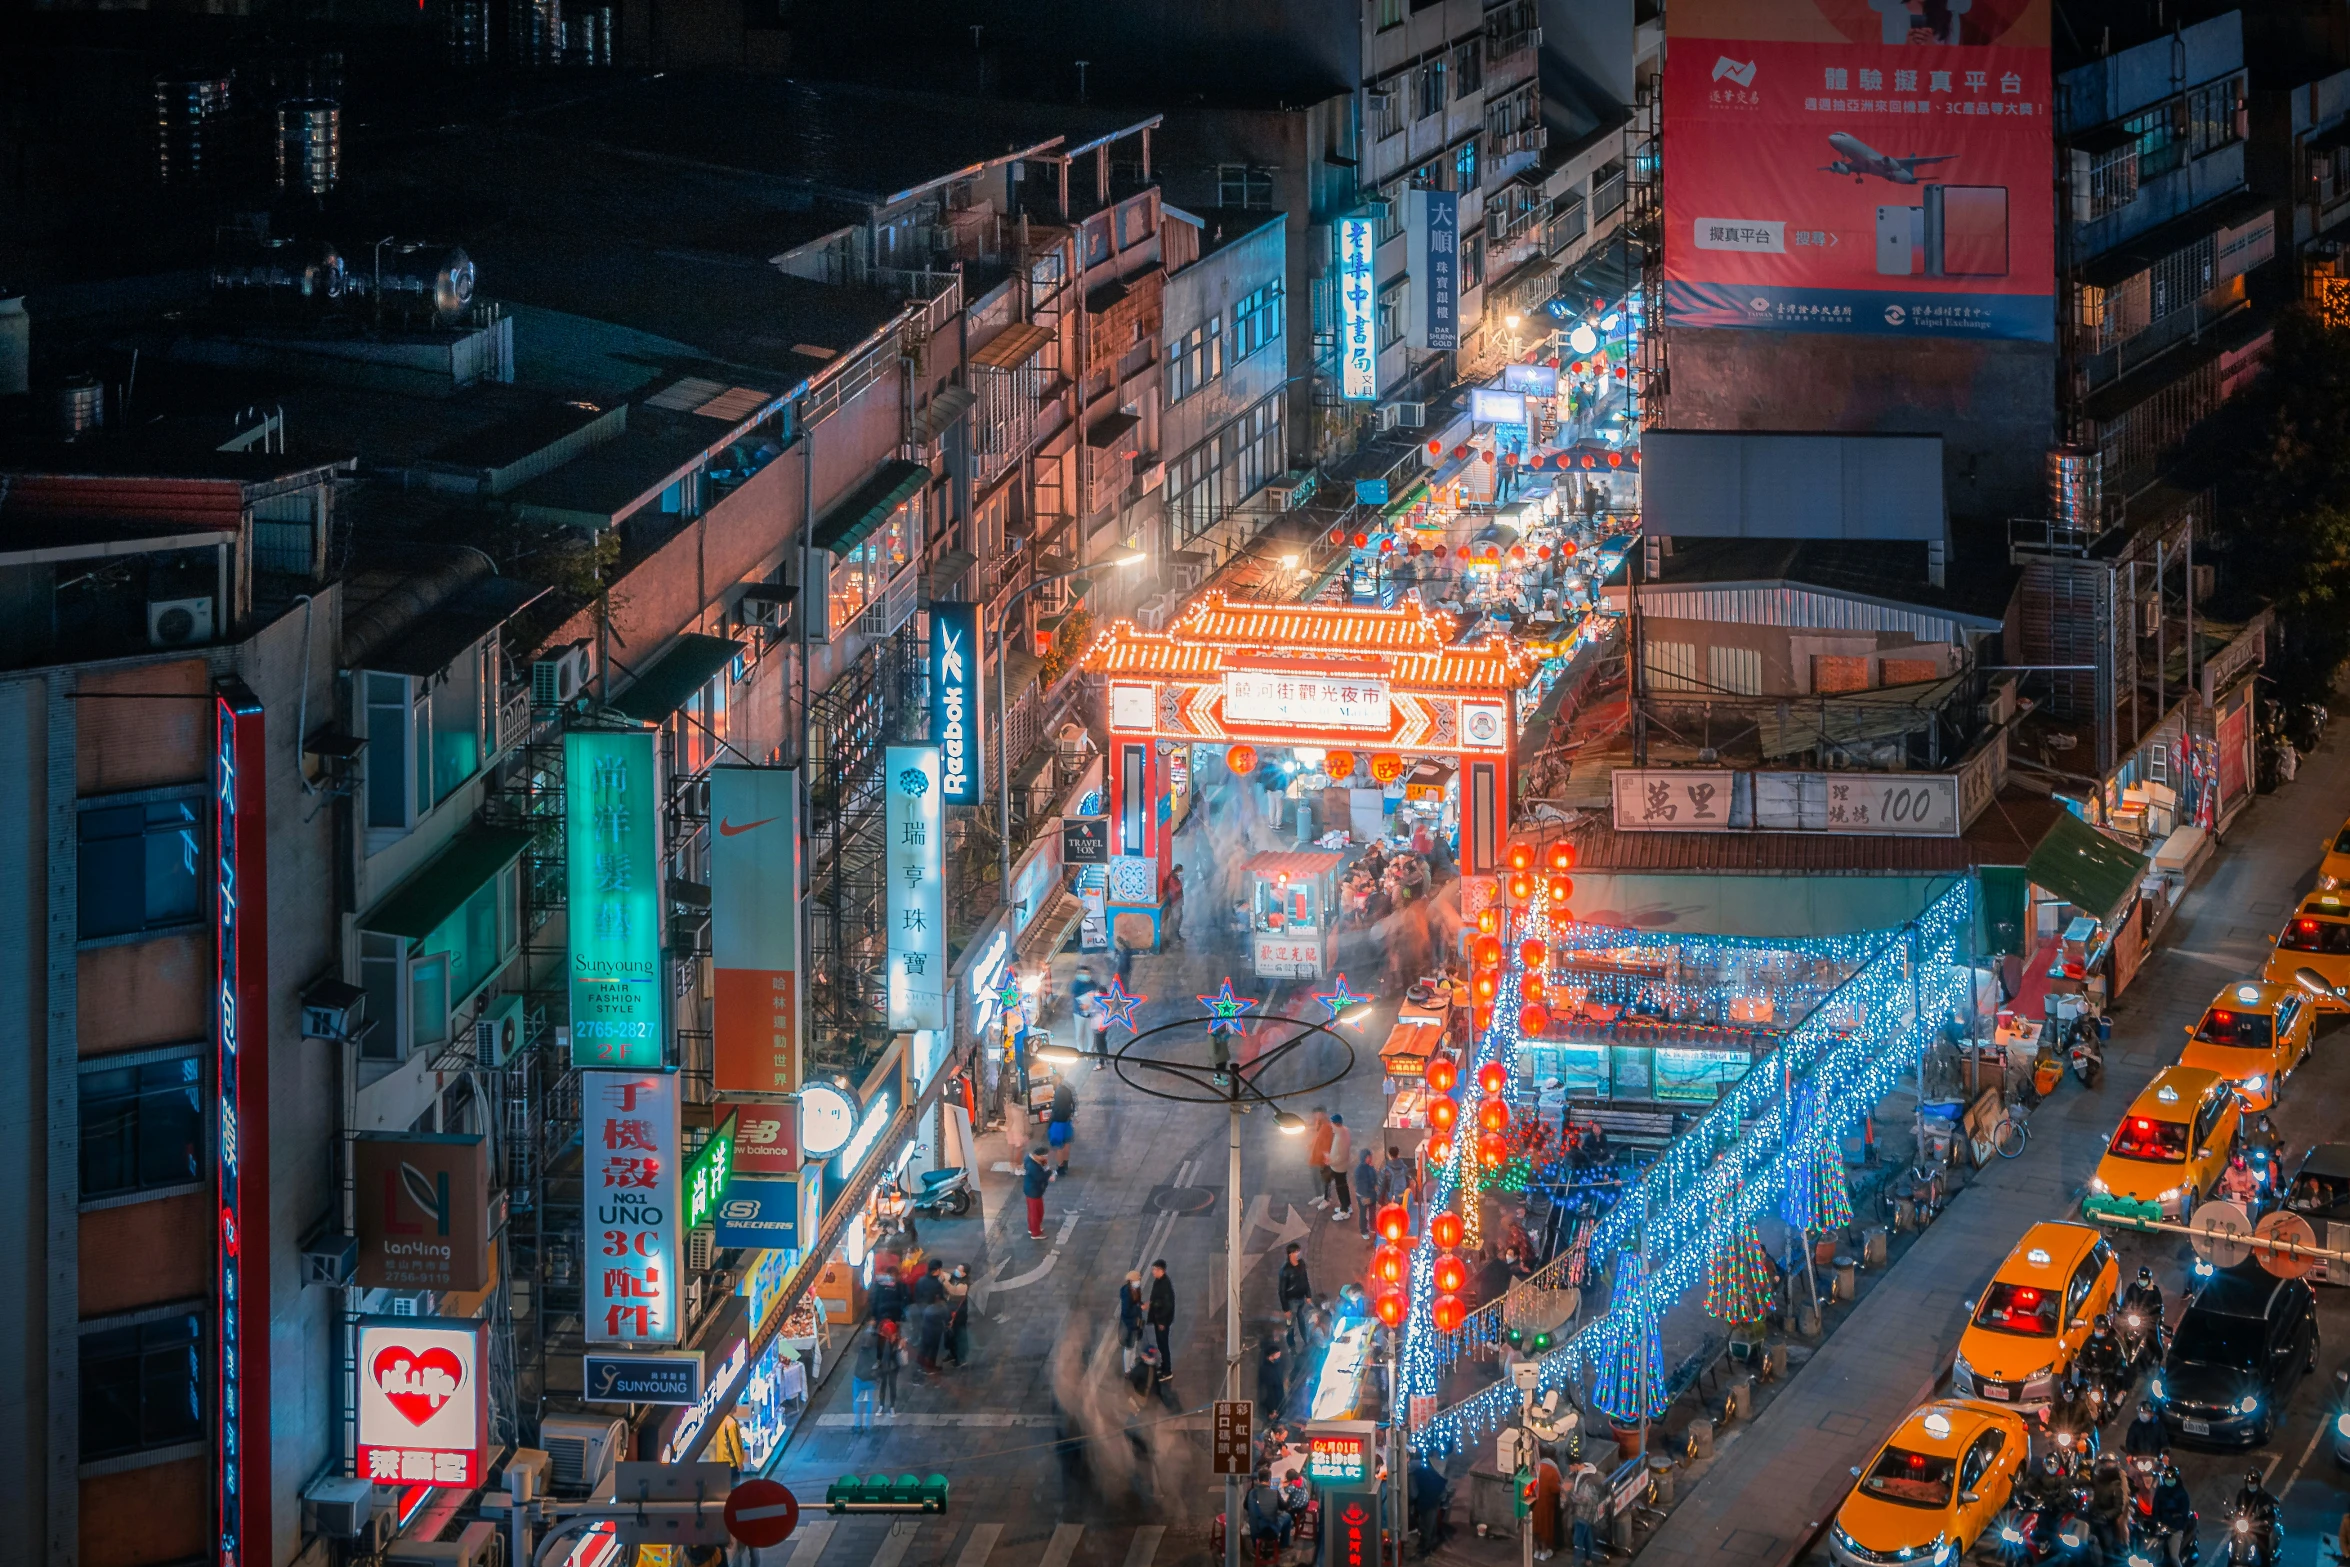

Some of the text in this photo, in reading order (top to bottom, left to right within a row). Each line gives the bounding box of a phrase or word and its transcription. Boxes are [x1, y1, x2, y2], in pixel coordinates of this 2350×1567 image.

[1824, 67, 2022, 95] 體驗擬真平台
[1708, 90, 1760, 105] 逐筆交易
[1430, 202, 1453, 255] 大順
[1709, 226, 1771, 245] 擬真平台
[1795, 230, 1826, 247] 搜尋
[1345, 221, 1372, 373] 老集中書局
[1436, 261, 1450, 320] 珠寶銀樓
[1434, 326, 1450, 334] DAR
[1913, 317, 1992, 330] Taipei Exchange
[1429, 332, 1456, 341] SHUENN
[1432, 339, 1453, 347] GOLD
[1361, 374, 1374, 397] 文具
[1234, 682, 1381, 706] 饒河街觀光夜市
[942, 686, 967, 795] Reebok
[1642, 780, 1717, 823] 萬里
[1880, 786, 1931, 824] 100
[1068, 837, 1104, 848] TRAVEL
[901, 820, 928, 977] 瑞亨珠寶
[1086, 937, 1106, 945] FILA
[1260, 944, 1318, 962] 歡迎光臨
[575, 953, 654, 976] Sunyoung
[600, 983, 630, 993] HAIR
[588, 993, 642, 1003] FASHION
[596, 1004, 634, 1014] STYLE
[576, 1020, 656, 1039] 2765-2827
[772, 976, 787, 1087] 哈林運動世界
[601, 1077, 661, 1190] 手機殼
[746, 1144, 789, 1157] balance
[613, 1192, 648, 1205] NO.1
[598, 1205, 664, 1227] UNO
[725, 1220, 795, 1231] SKECHERS
[616, 1379, 688, 1394] SUNYOUNG
[1217, 1403, 1231, 1454] 錫口碼頭
[1235, 1403, 1249, 1455] 彩虹橋
